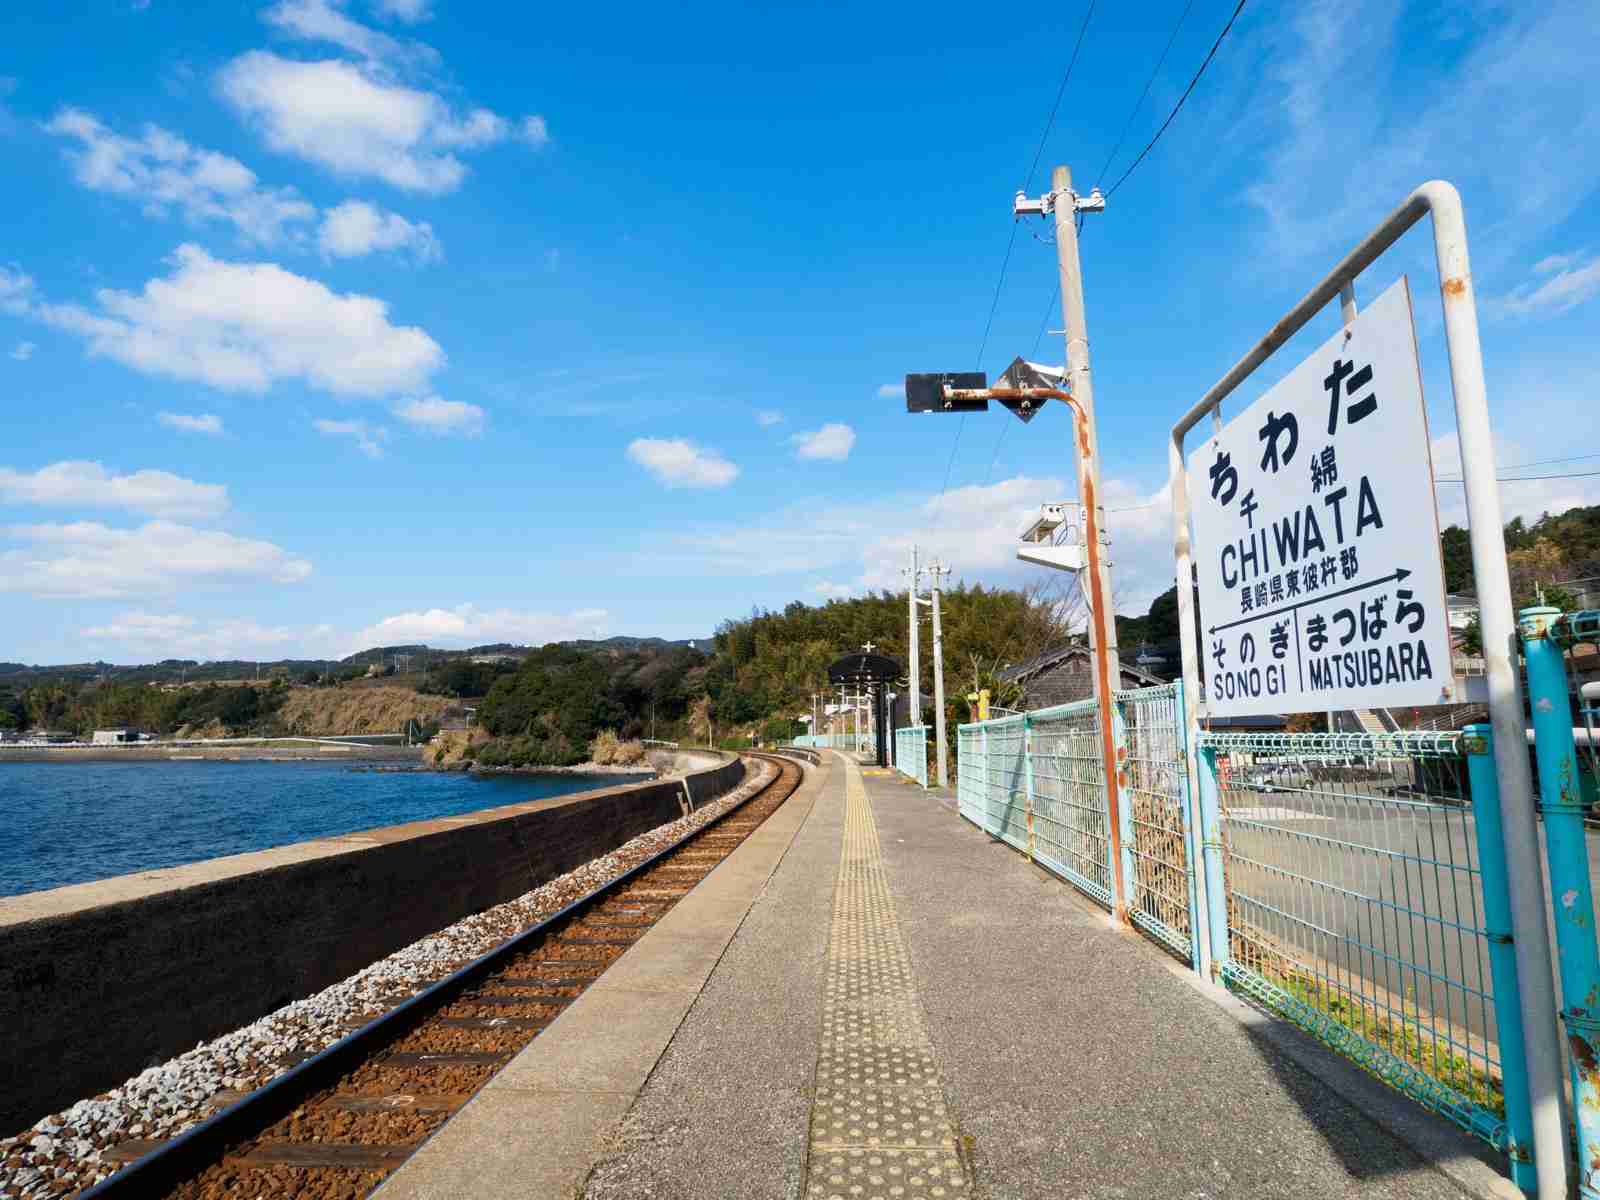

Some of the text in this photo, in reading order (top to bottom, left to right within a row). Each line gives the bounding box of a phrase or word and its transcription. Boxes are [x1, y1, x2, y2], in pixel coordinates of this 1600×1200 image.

[1209, 358, 1378, 507] ちわた
[1239, 446, 1338, 530] 千綿
[1220, 475, 1384, 589] CHIWATA
[1240, 545, 1359, 615] 長崎県東彼杵郡
[1212, 618, 1290, 670] そのぎ
[1306, 588, 1425, 653] まつばら
[1213, 663, 1286, 701] SONOGI
[1308, 639, 1433, 693] MATSUBARA
